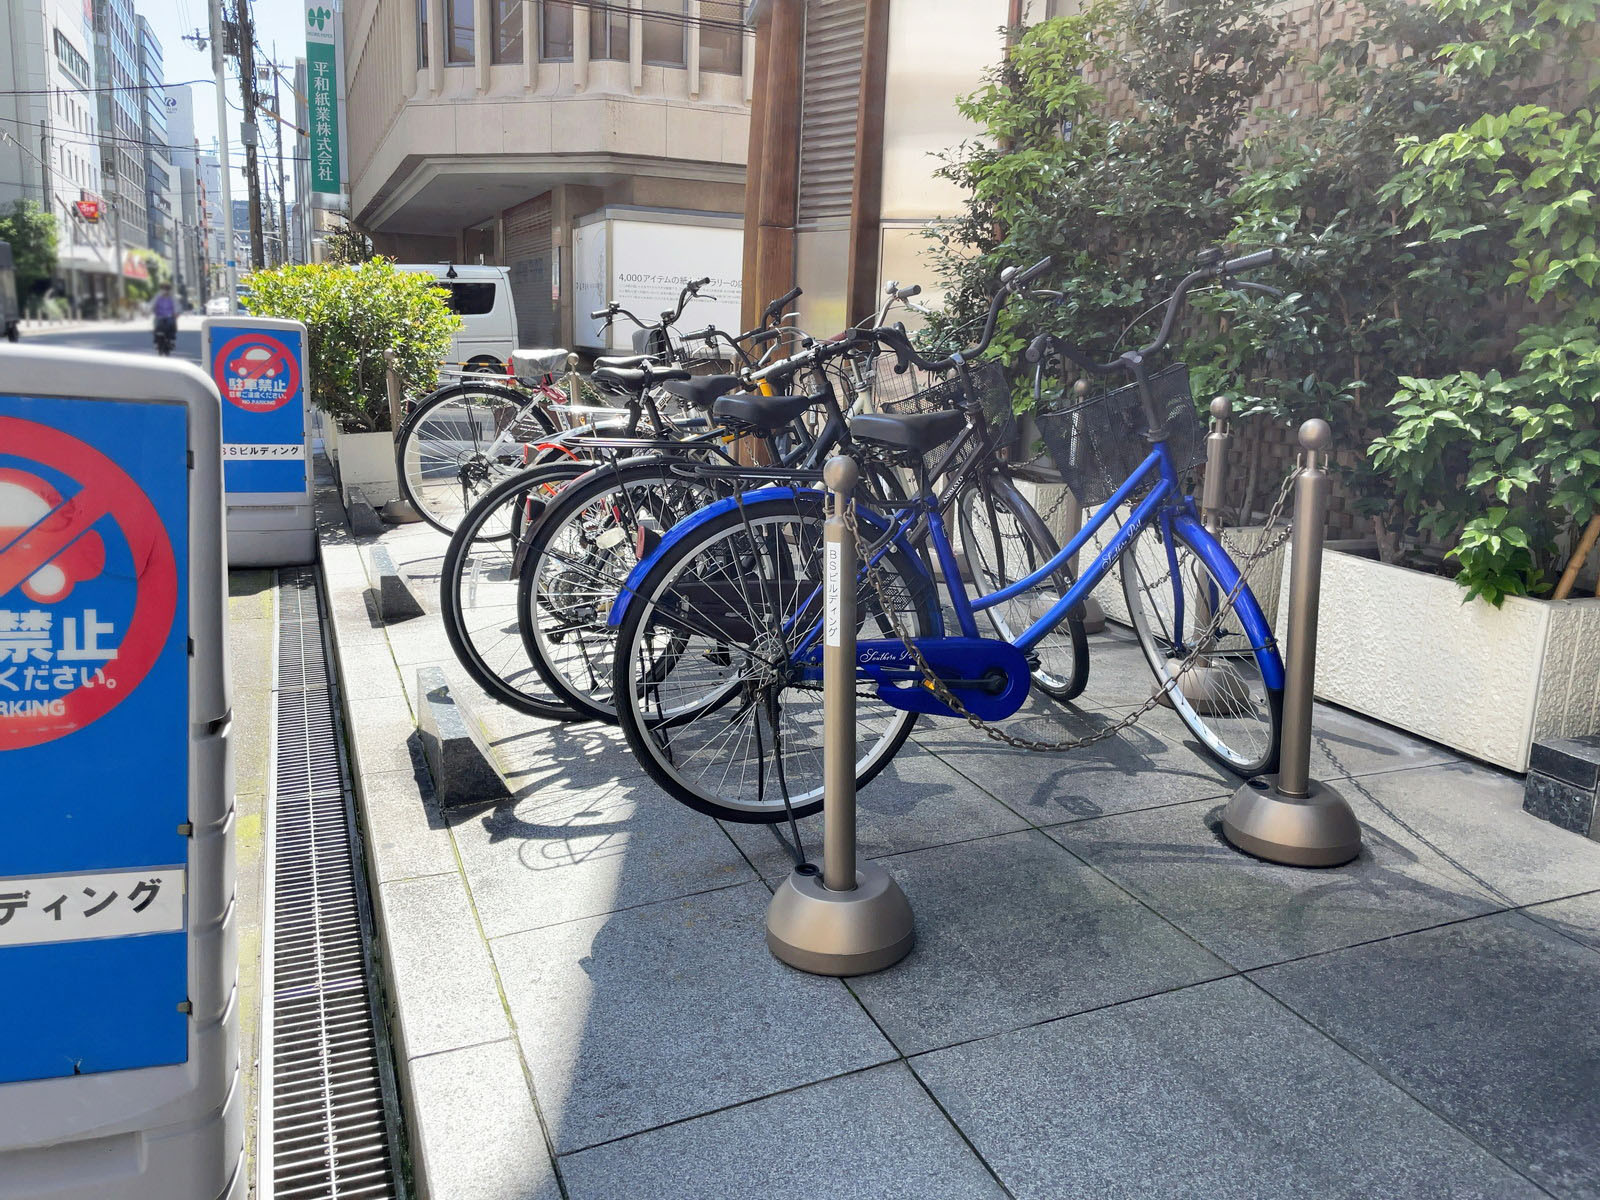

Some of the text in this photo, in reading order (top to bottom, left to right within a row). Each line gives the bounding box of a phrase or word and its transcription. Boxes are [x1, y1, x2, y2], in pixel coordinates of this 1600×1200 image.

[313, 61, 334, 181] 平和紙業株式会社
[229, 377, 287, 392] 駐車禁止
[829, 549, 838, 637] BSビルディング
[0, 609, 118, 664] 禁止
[860, 648, 896, 663] Southern
